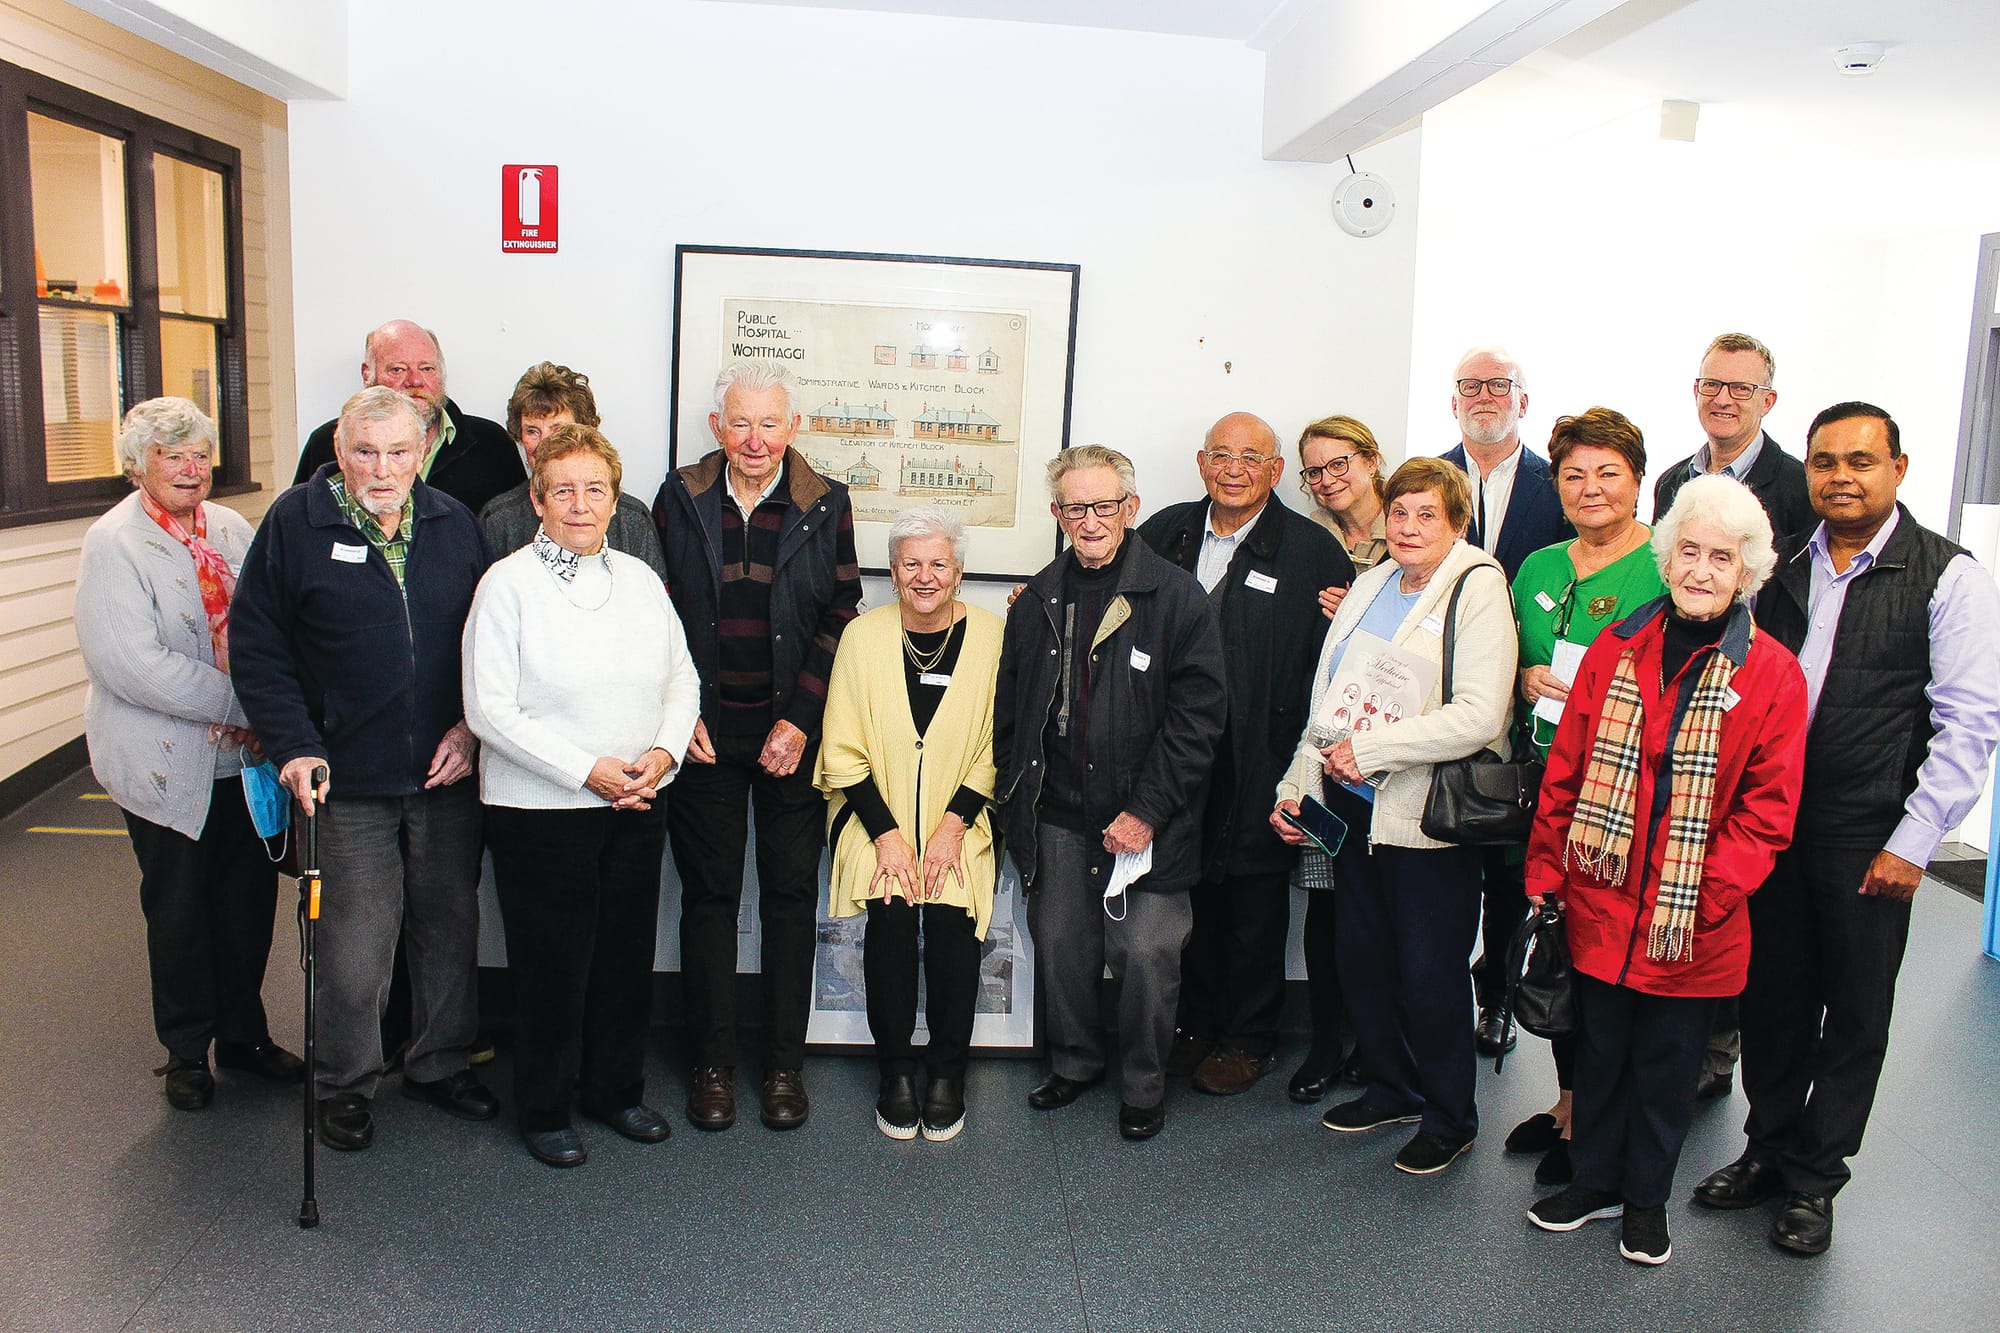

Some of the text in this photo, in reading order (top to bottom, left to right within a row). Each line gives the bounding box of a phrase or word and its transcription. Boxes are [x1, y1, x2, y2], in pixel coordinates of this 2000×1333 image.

[521, 229, 539, 237] FIRE
[503, 240, 557, 249] EXTINGUISHER
[737, 310, 777, 325] PUBLIC
[737, 325, 791, 340] HOSPITAL
[731, 343, 805, 360] WONTHAGGI
[867, 379, 900, 391] WARDS
[909, 381, 946, 393] KITCHEN
[954, 383, 985, 395] BLOCK
[840, 438, 876, 447] ELEVATION
[889, 441, 918, 450] KITCHEN
[920, 442, 945, 451] BLOCK
